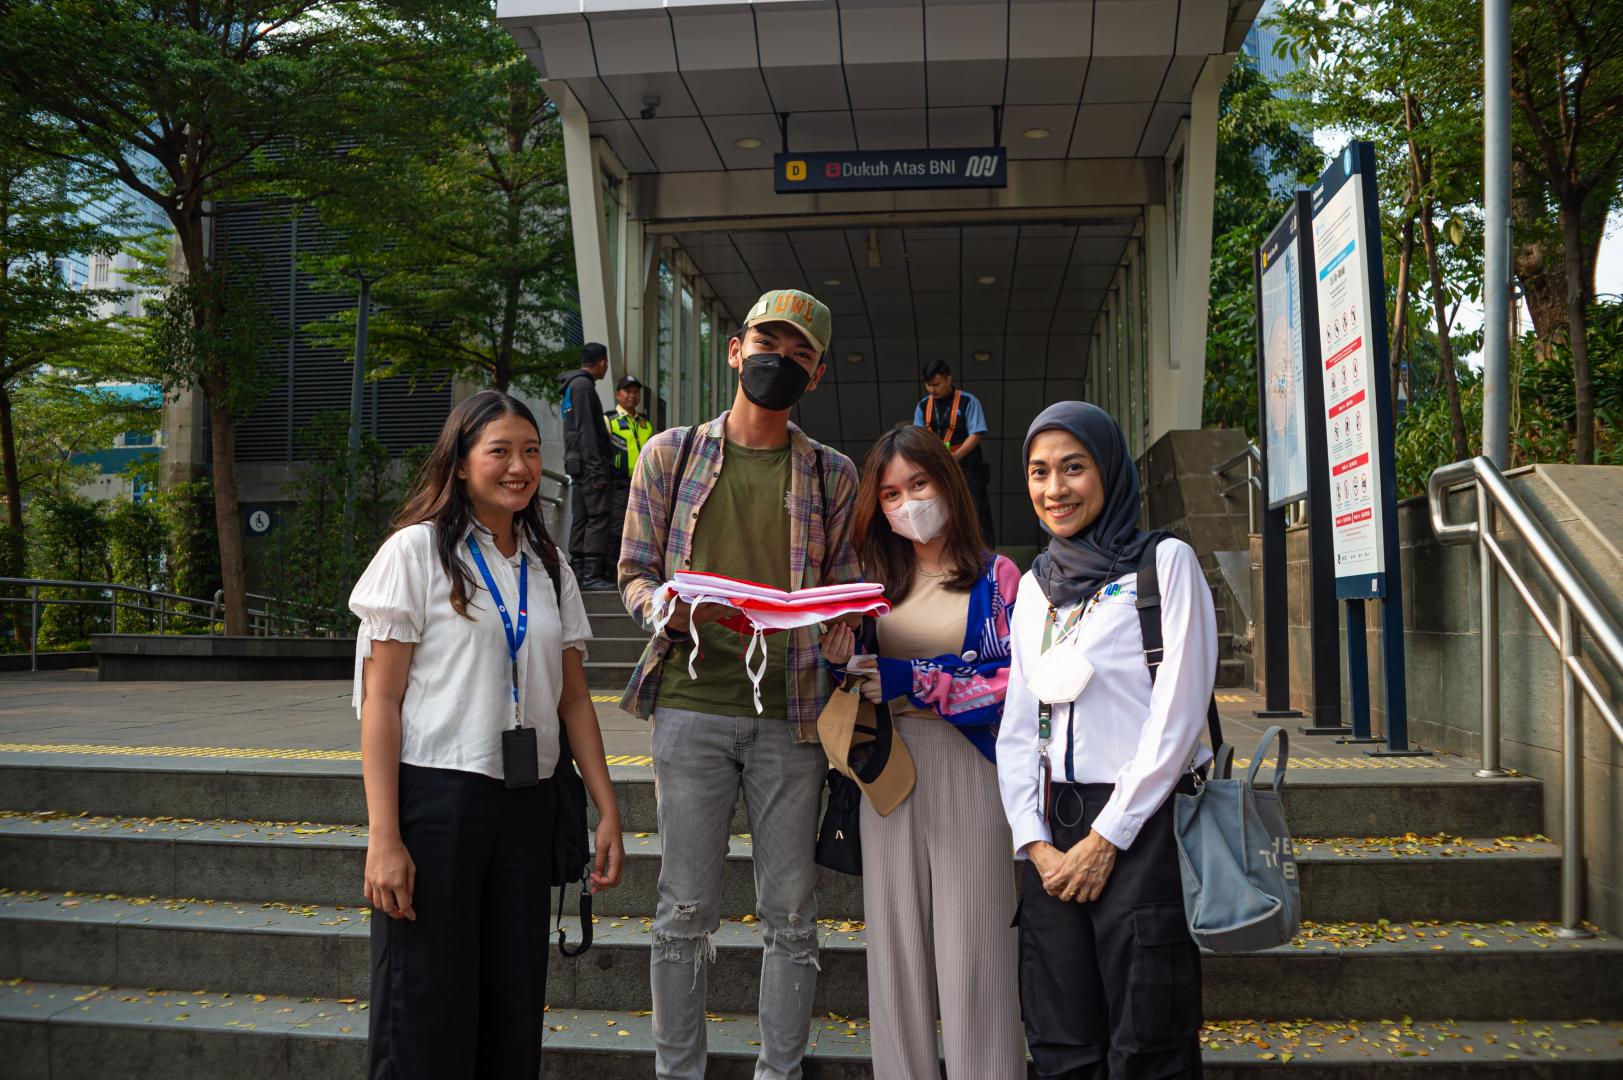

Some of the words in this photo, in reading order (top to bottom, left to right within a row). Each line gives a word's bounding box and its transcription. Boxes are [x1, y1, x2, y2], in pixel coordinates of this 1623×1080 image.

[843, 161, 888, 177] Dukuh
[893, 160, 926, 175] Atas
[929, 159, 956, 174] BNI
